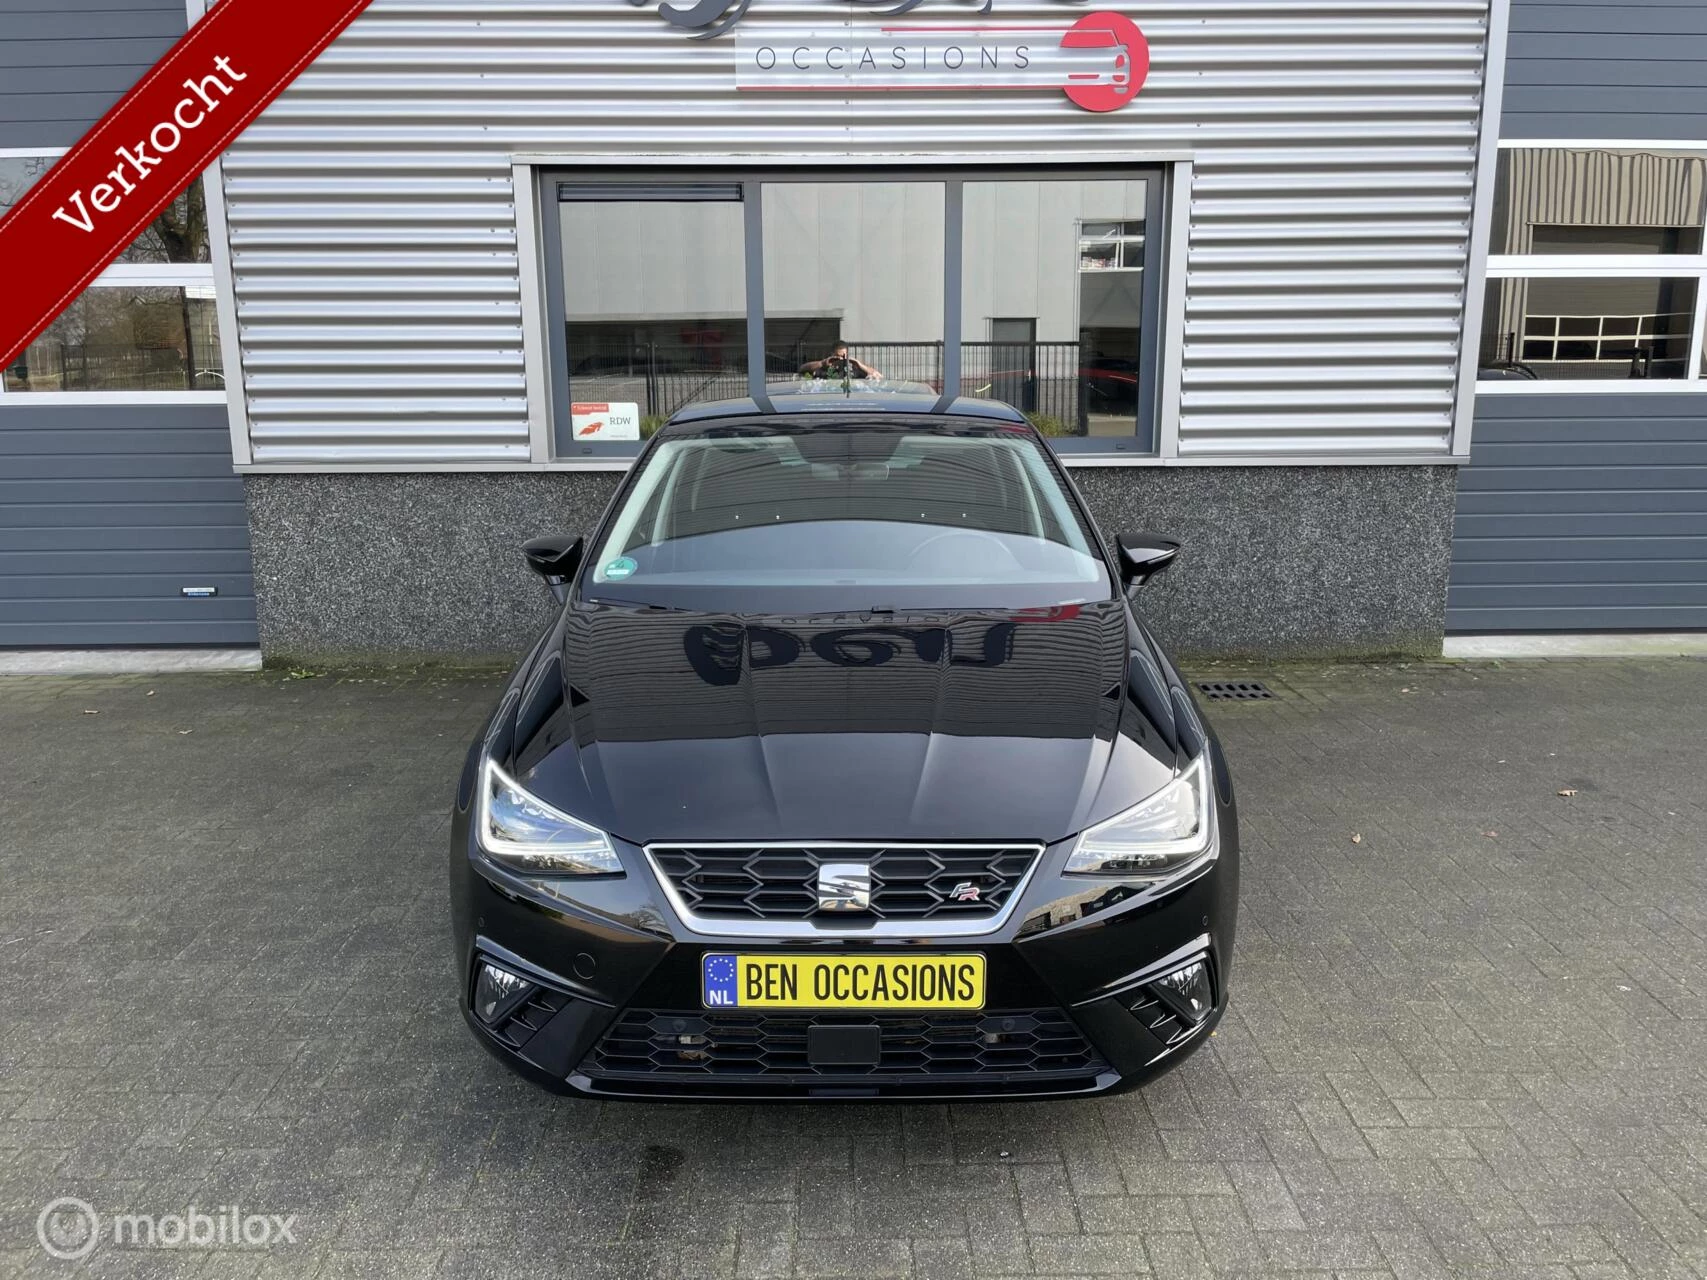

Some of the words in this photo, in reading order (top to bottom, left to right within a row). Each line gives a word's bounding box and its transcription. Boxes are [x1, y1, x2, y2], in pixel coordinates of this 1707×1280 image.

[755, 46, 1031, 70] OCCASIONS
[609, 416, 631, 425] RDW
[949, 882, 980, 901] FR
[746, 963, 798, 1001] BEN
[813, 963, 975, 1002] OCCASIONS
[709, 989, 733, 1004] NL
